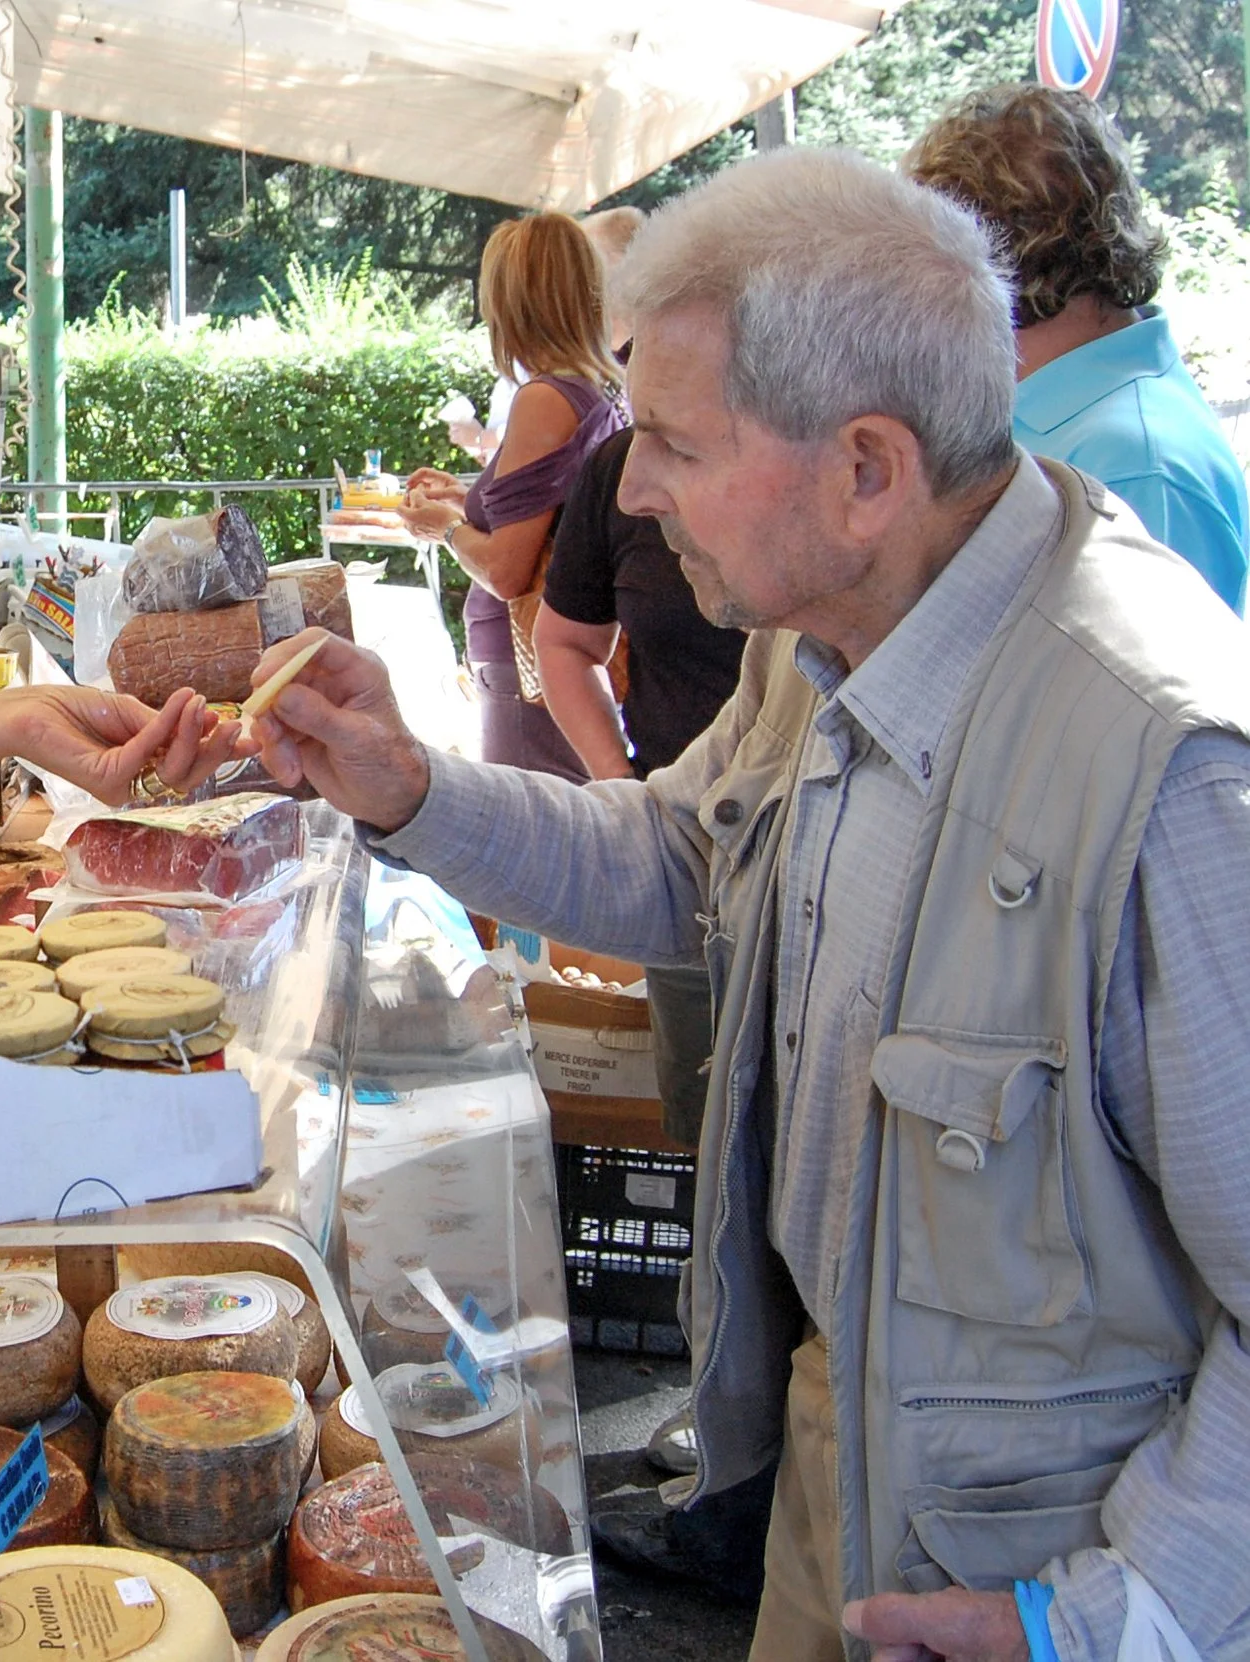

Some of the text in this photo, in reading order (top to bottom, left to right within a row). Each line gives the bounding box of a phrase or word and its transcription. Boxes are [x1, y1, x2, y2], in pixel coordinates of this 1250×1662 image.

[544, 1050, 571, 1064] MERCE
[560, 1066, 600, 1081] TENERE IN
[566, 1081, 591, 1092] FRIGO
[28, 1586, 66, 1650] Pecorino
